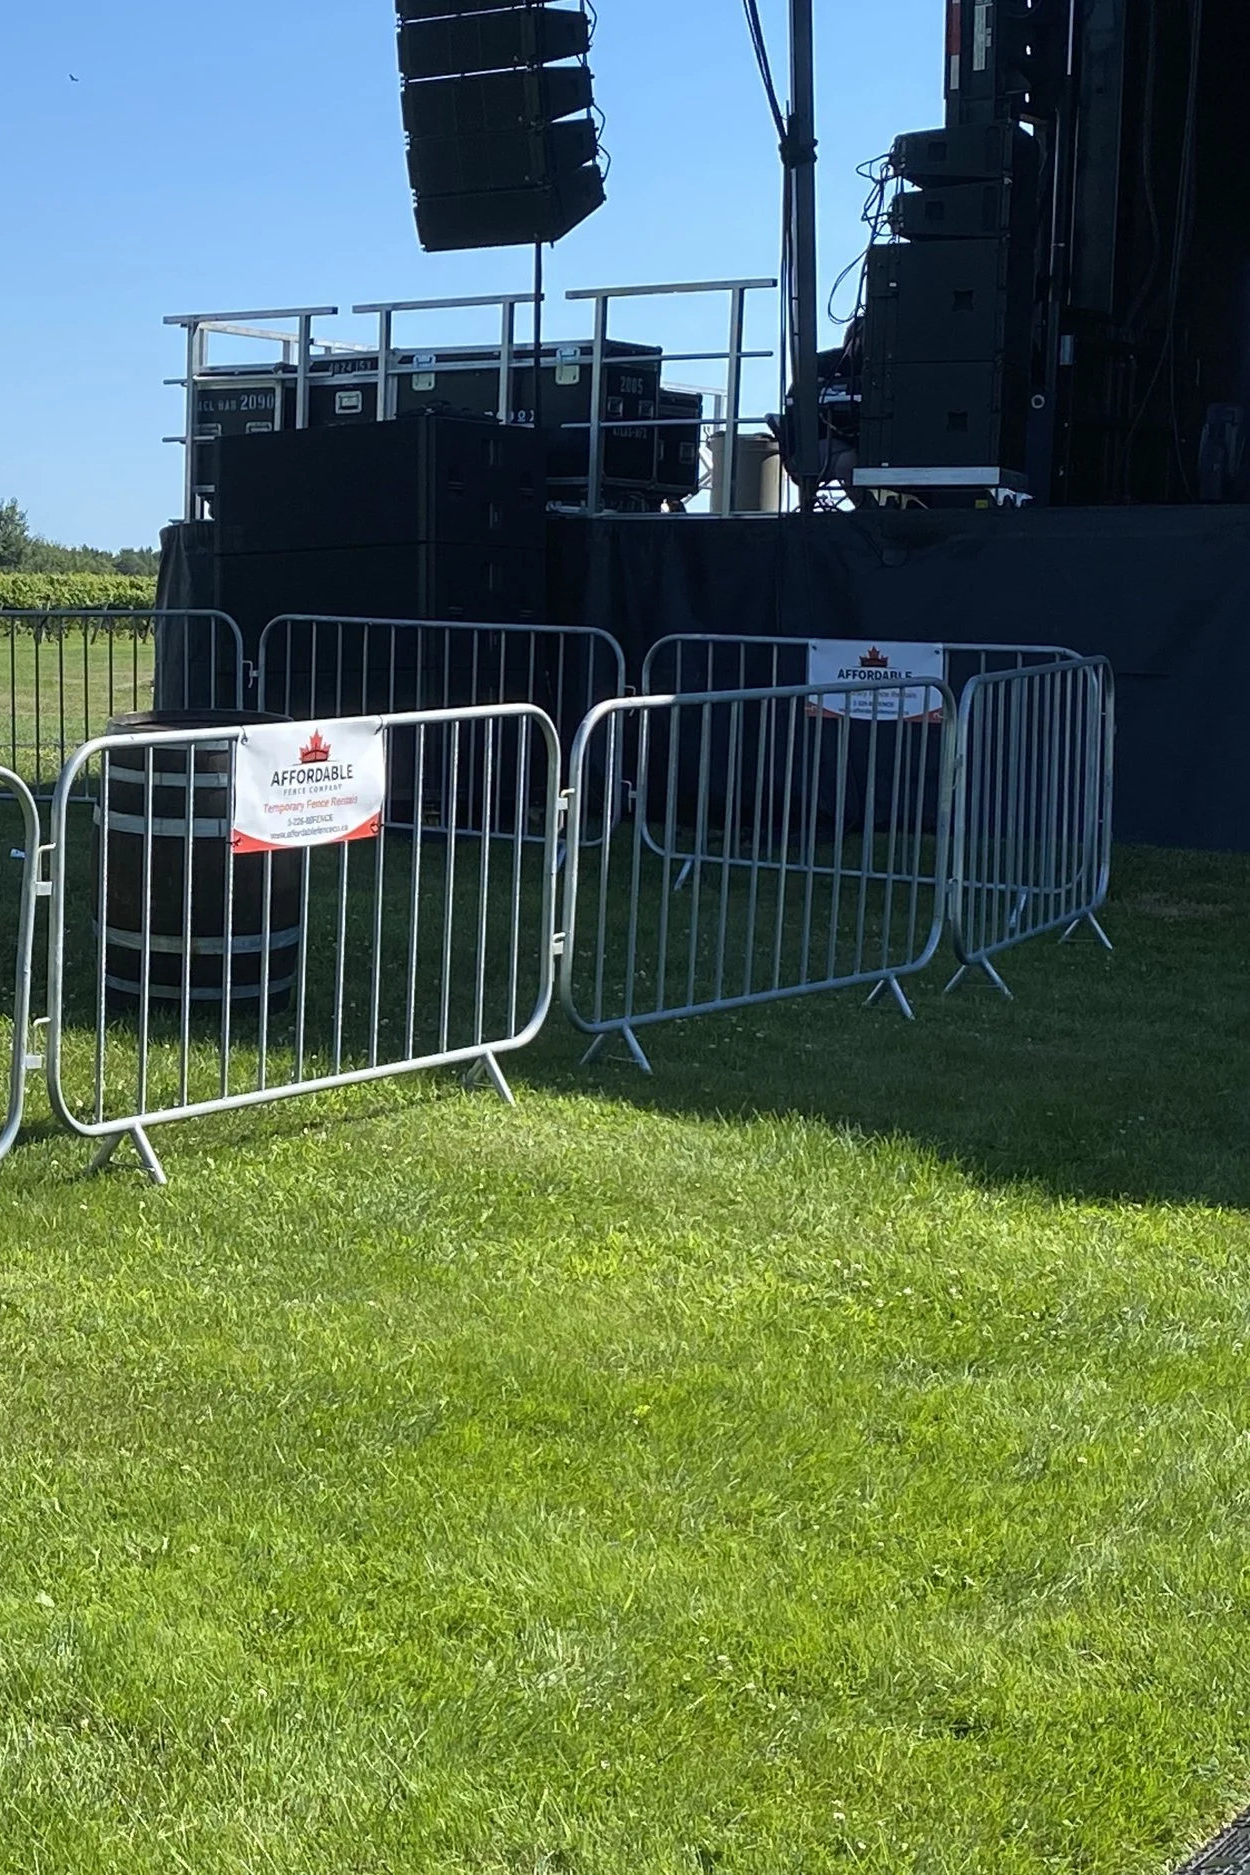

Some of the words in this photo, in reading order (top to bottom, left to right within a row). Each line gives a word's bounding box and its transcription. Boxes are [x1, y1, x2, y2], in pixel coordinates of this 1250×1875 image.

[240, 394, 275, 411] 2090
[270, 764, 354, 787] AFFORDABLE
[283, 787, 306, 796] FENCE
[309, 784, 343, 794] COMPANY
[263, 802, 305, 814] Temporary
[306, 799, 330, 809] Fence
[330, 796, 358, 807] Rentals
